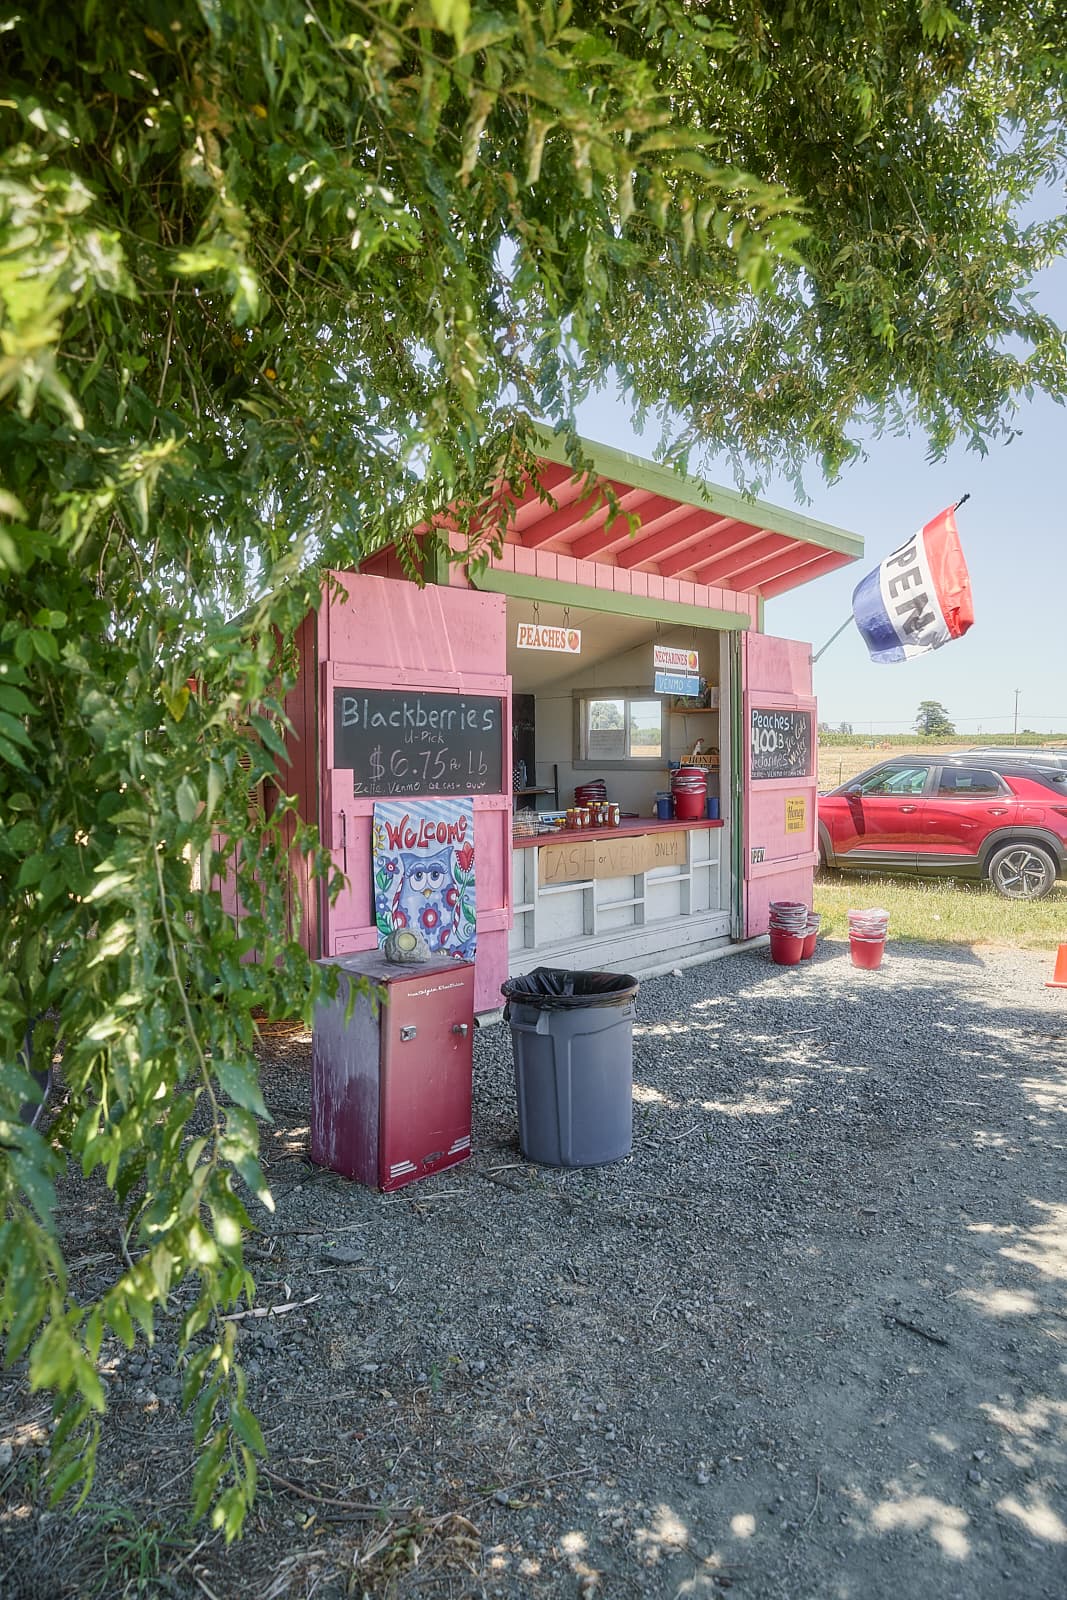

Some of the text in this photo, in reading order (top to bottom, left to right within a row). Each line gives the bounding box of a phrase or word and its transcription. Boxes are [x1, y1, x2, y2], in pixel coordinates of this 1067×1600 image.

[887, 534, 936, 636] PEN
[518, 626, 566, 648] PEACHES
[655, 650, 688, 666] NECTARINES
[341, 697, 495, 731] Blackberries
[752, 710, 794, 731] Peaches!
[404, 730, 445, 744] U-Pick
[369, 744, 449, 782] $6.75
[545, 848, 595, 880] CASH
[598, 856, 607, 864] or
[655, 841, 679, 857] ONLY!
